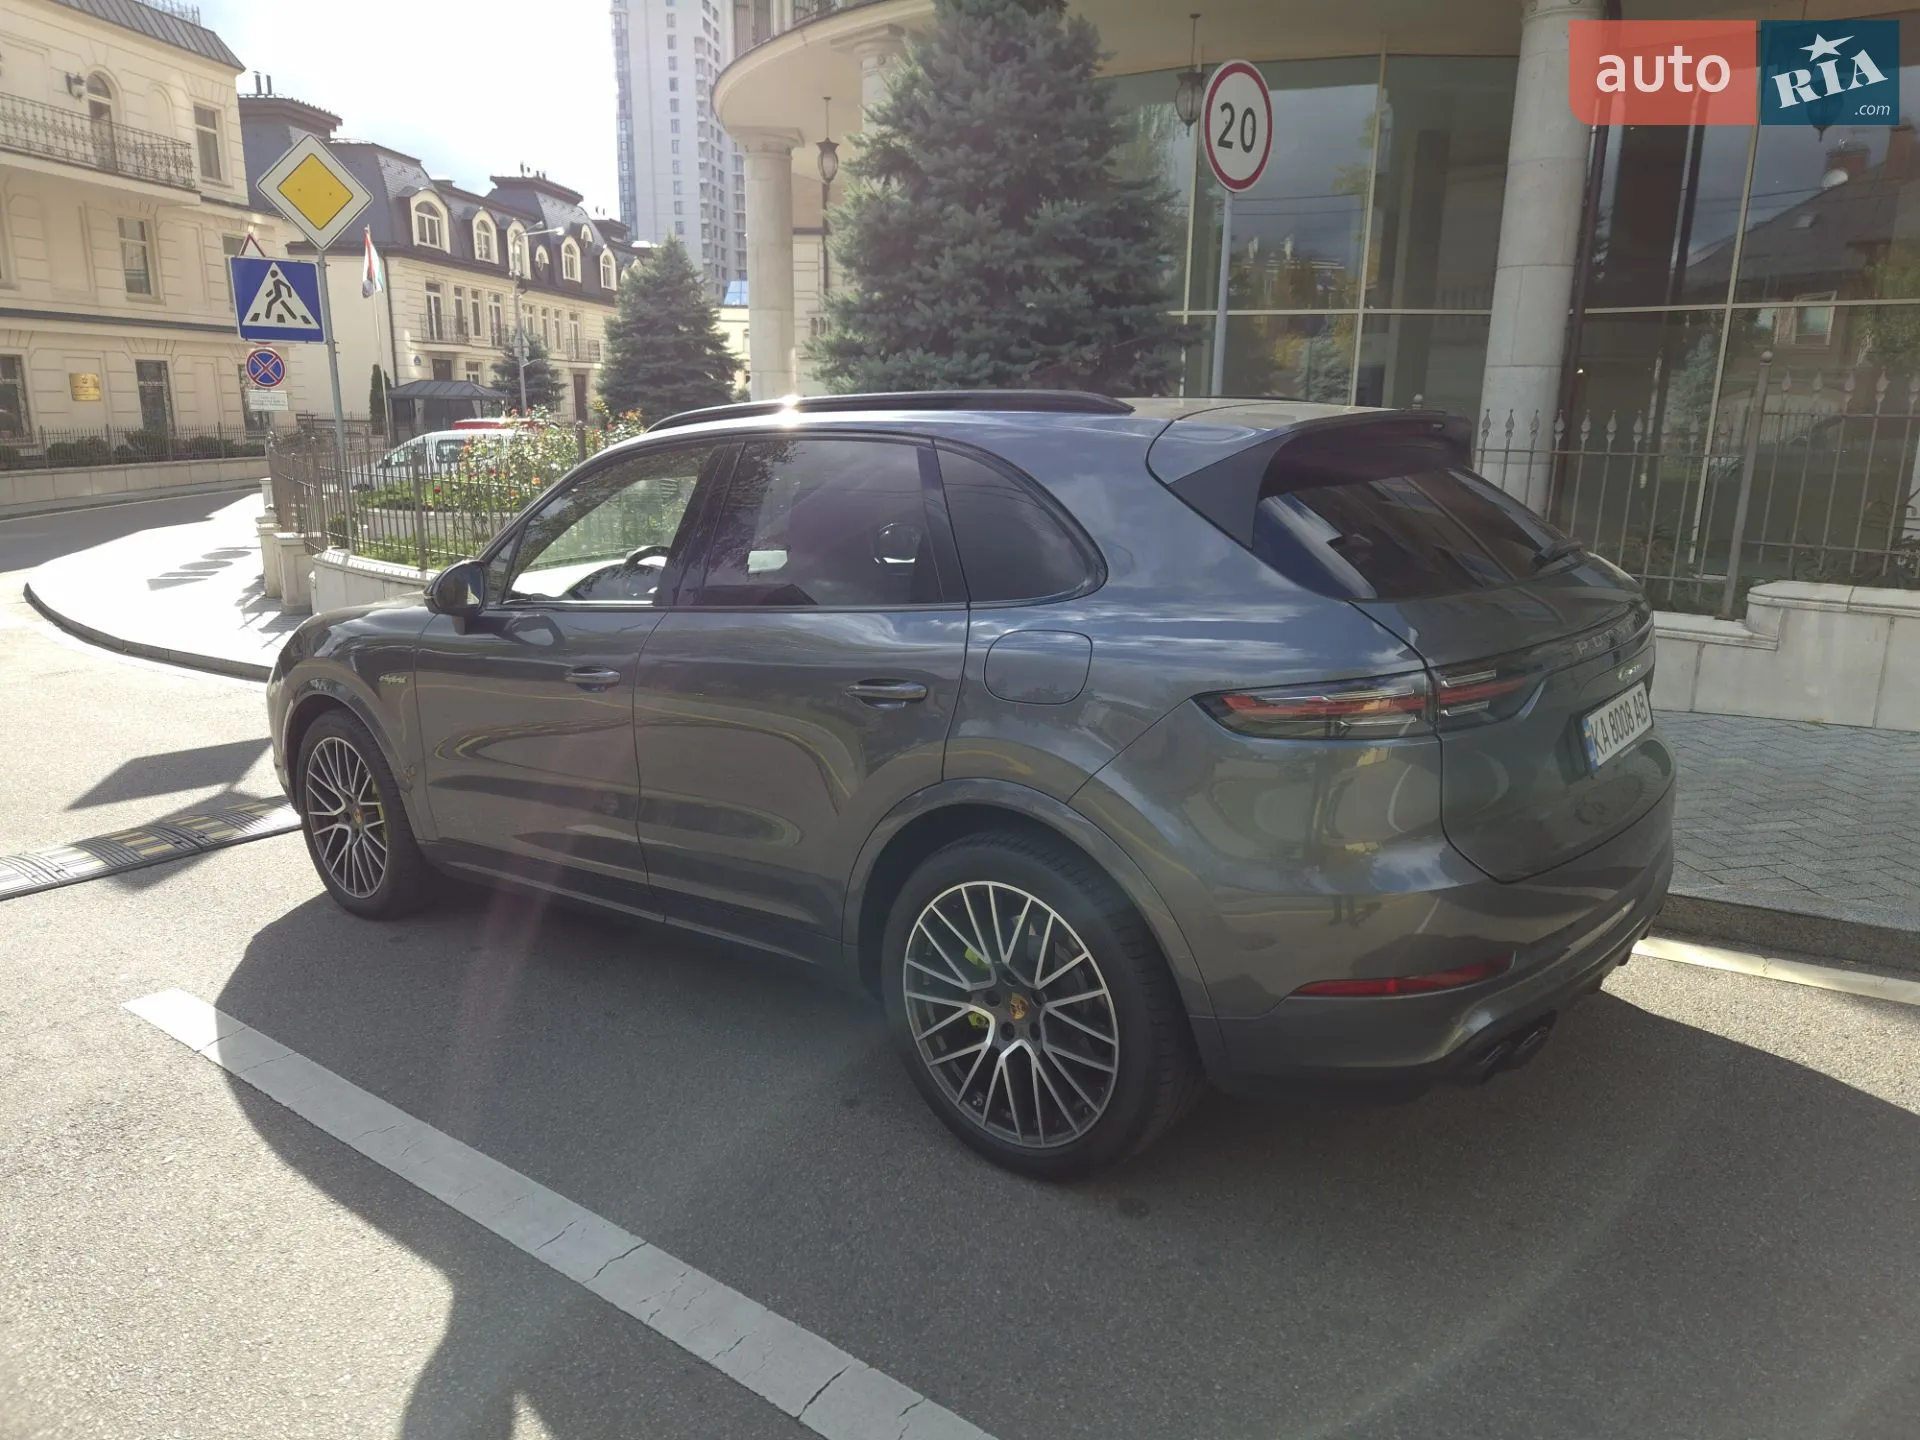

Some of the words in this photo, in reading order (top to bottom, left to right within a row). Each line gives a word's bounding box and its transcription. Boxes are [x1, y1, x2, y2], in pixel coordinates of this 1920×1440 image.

[1217, 101, 1257, 154] 20
[1590, 717, 1613, 758] KA
[1608, 699, 1636, 745] 8008
[1633, 690, 1648, 728] AB
